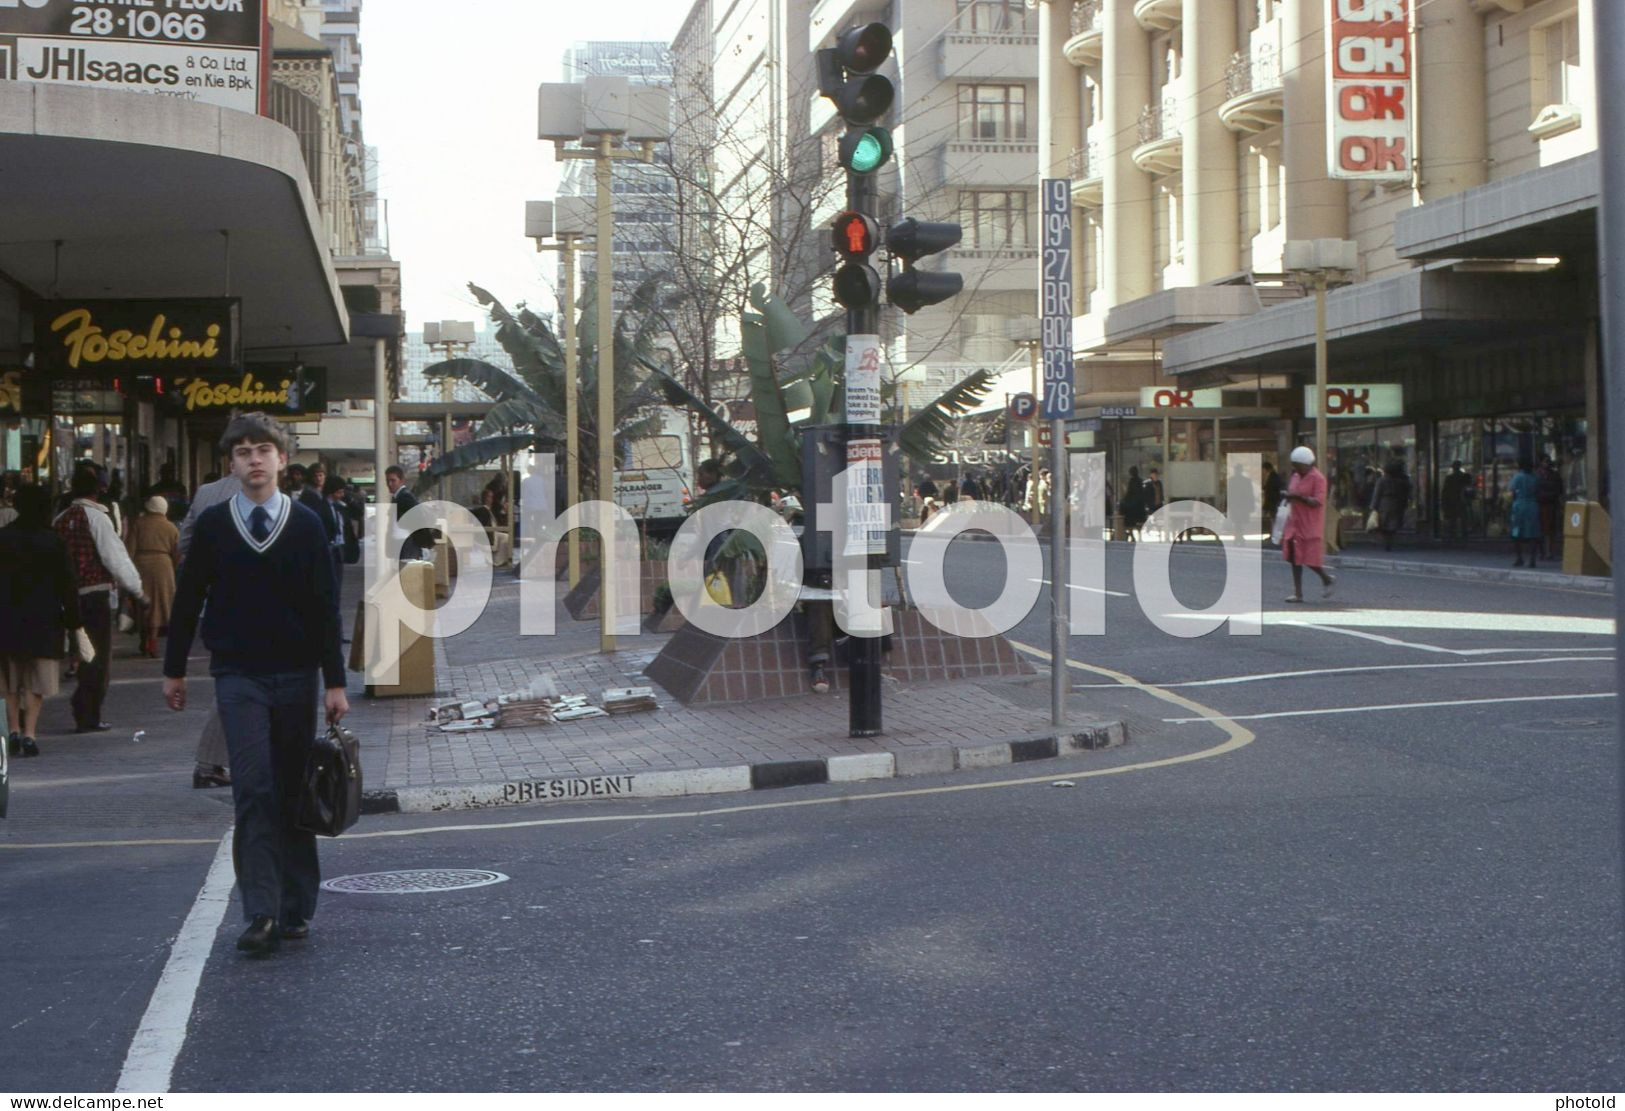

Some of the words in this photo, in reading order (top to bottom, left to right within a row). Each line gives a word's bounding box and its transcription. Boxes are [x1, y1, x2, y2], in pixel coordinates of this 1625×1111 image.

[186, 56, 195, 68] &
[1338, 36, 1406, 74] OK
[185, 76, 202, 87] en
[1339, 85, 1405, 121] OK
[1340, 136, 1406, 172] OK
[1044, 180, 1068, 212] 19
[1044, 214, 1071, 247] 19A
[1043, 249, 1071, 281] 27
[1044, 282, 1071, 315] BR
[51, 308, 220, 368] Foschini
[174, 373, 290, 411] Foschini
[1018, 401, 1030, 414] P
[1046, 382, 1070, 413] 78
[1154, 390, 1195, 408] OK
[1326, 388, 1370, 414] OK
[503, 775, 636, 801] PRESIDENT
